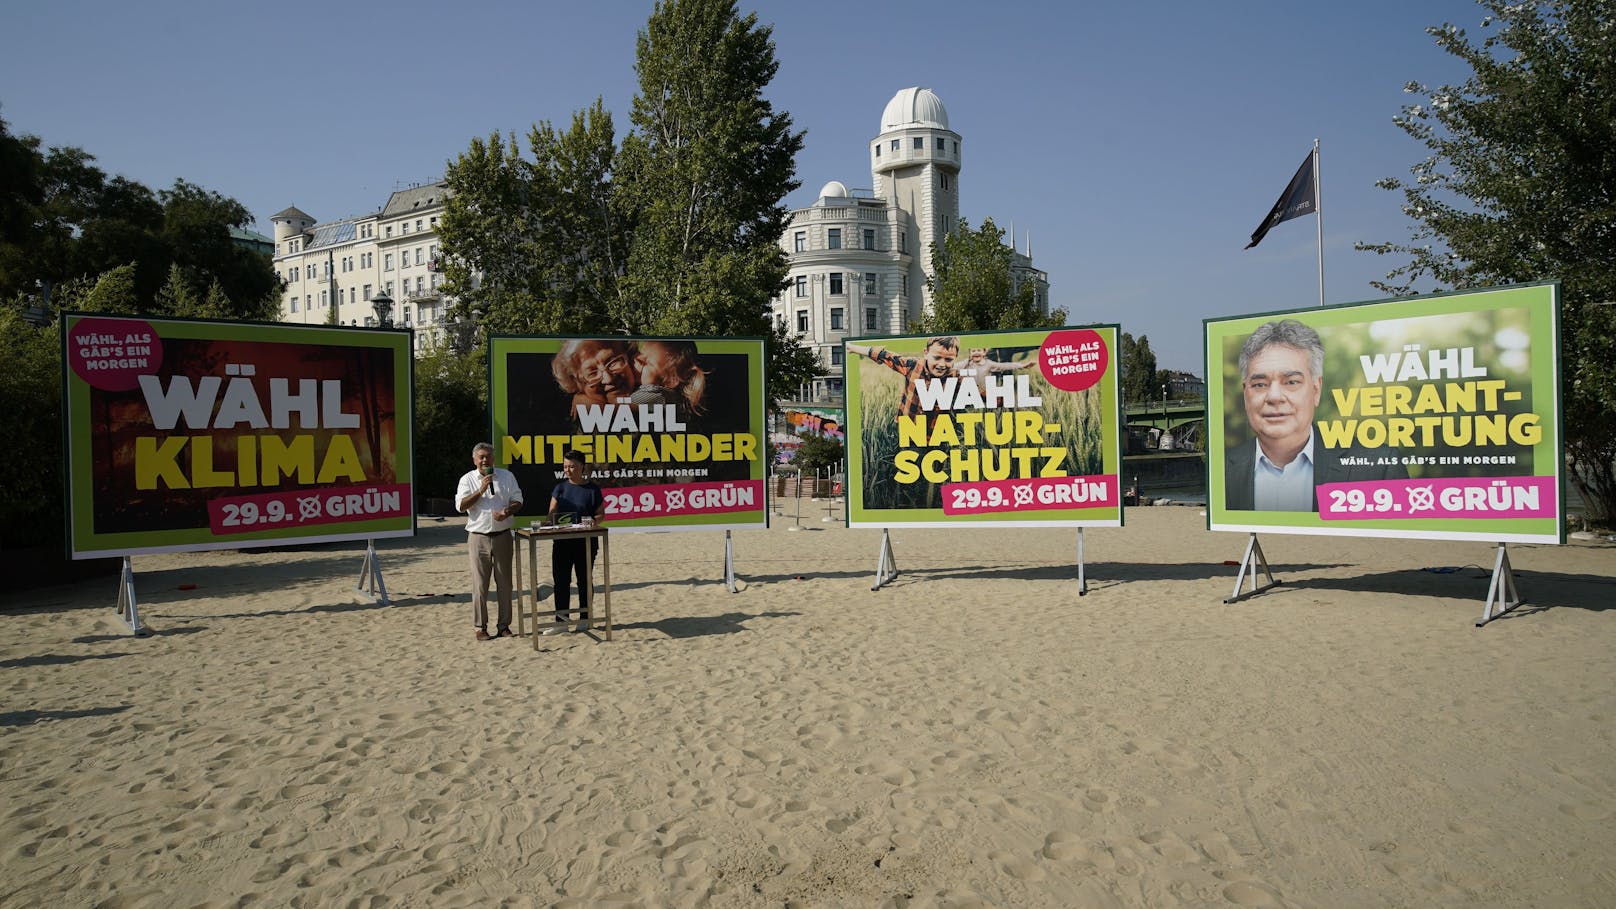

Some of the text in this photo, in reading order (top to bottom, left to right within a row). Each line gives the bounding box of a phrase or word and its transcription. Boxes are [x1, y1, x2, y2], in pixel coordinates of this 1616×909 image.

[75, 333, 152, 346] WÄHL, ALS
[80, 346, 151, 358] GÄB'S EIN
[1045, 341, 1100, 357] WÄHL, ALS
[86, 358, 148, 370] MORGEN
[1048, 352, 1099, 366] GÄB'S EIN
[1052, 362, 1097, 376] MORGEN
[1359, 344, 1487, 384] WÄHL
[138, 364, 360, 430] WÄHL
[914, 368, 1042, 411] WÄHL
[1332, 379, 1522, 417] VERANT-
[576, 397, 686, 433] WÄHL
[898, 411, 1061, 448] NATUR-
[1316, 412, 1543, 449] WORTUNG
[135, 434, 367, 490] KLIMA
[502, 433, 757, 465] MITEINANDER
[1340, 455, 1516, 467] WÄHL, ALS GÄB'S EIN MORGEN
[590, 470, 611, 479] ALS
[613, 468, 644, 478] GÄB'S
[646, 469, 664, 478] EIN
[666, 468, 709, 477] MORGEN
[894, 447, 1067, 484] SCHUTZ
[222, 488, 400, 526] 29.9. GRÜN
[604, 483, 754, 514] 29.9. GRÜN
[952, 478, 1108, 509] 29.9. GRÜN
[1329, 480, 1540, 513] 29.9. GRÜN
